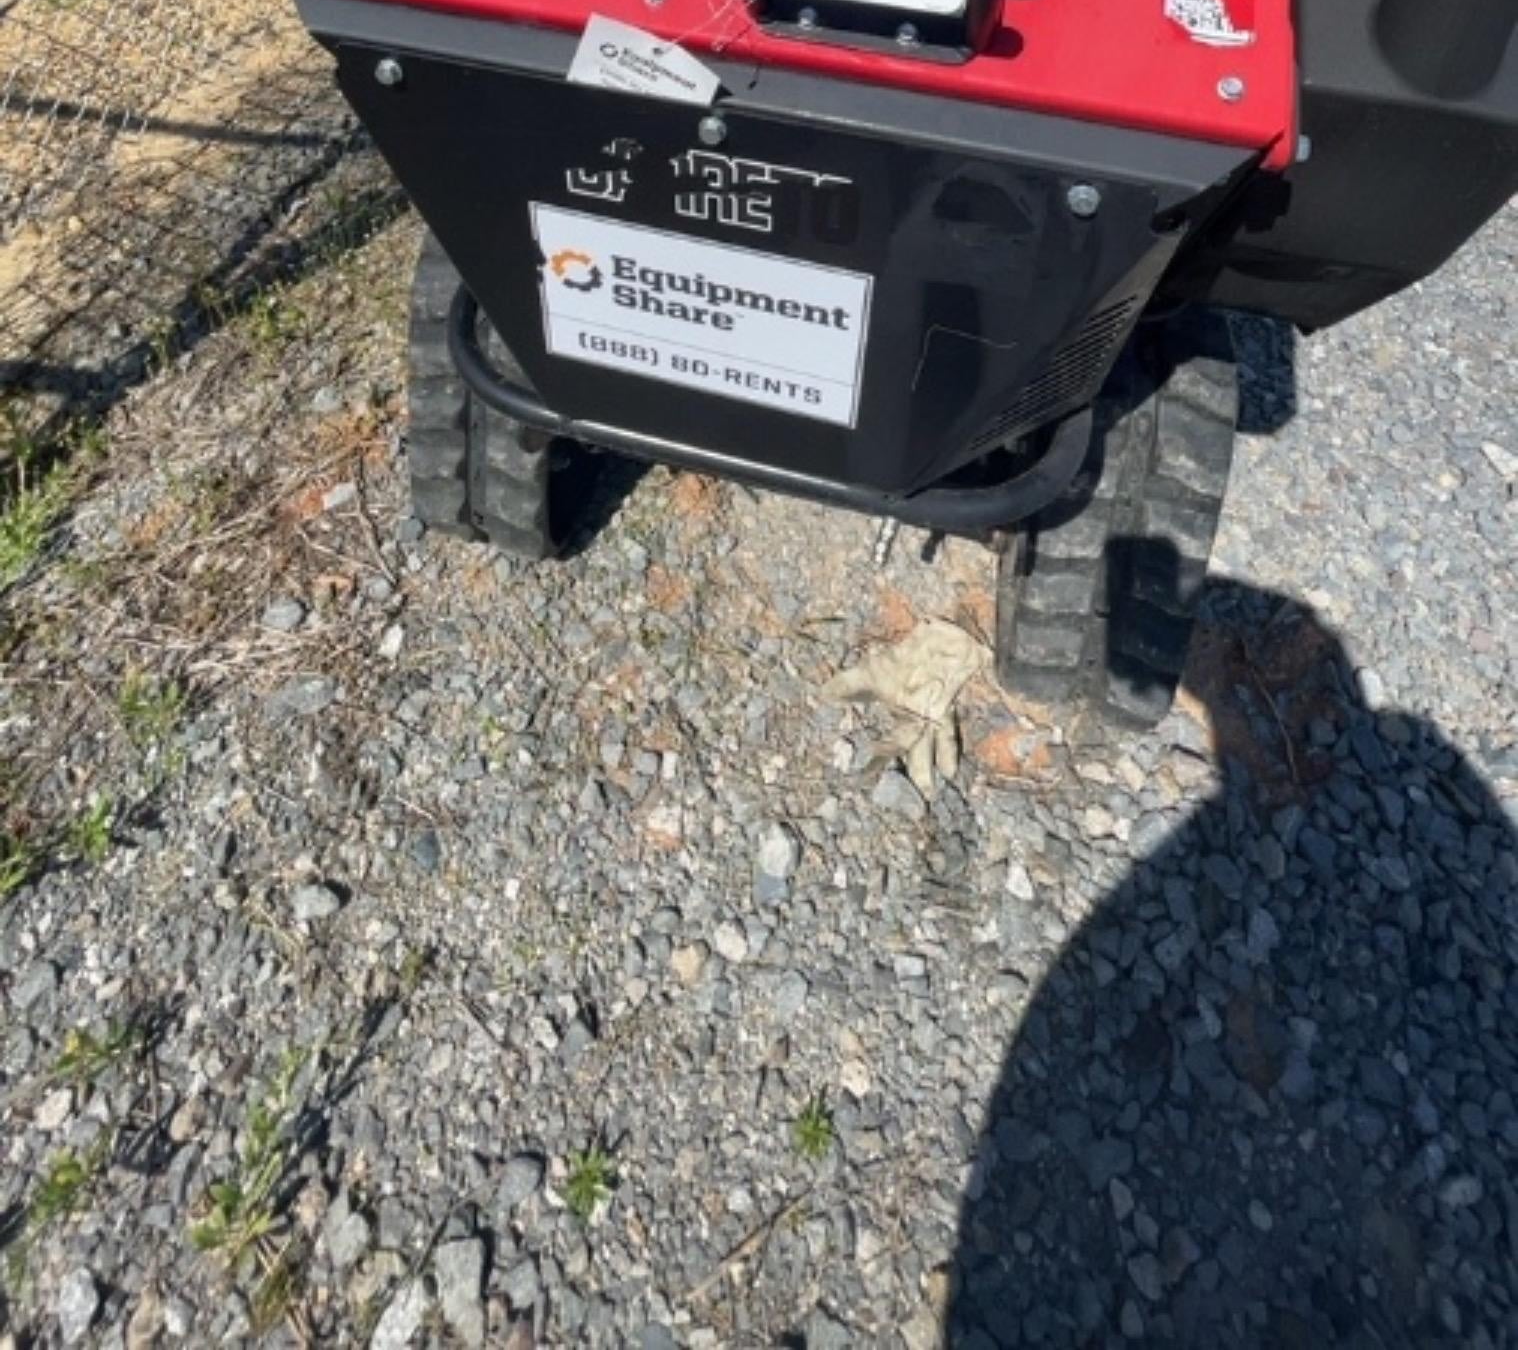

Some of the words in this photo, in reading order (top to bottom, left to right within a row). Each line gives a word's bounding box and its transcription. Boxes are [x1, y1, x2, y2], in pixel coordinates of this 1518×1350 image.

[611, 253, 851, 331] Equipment
[611, 283, 735, 331] Share
[579, 331, 659, 366] (888)
[670, 354, 823, 405] 80-RENTS
